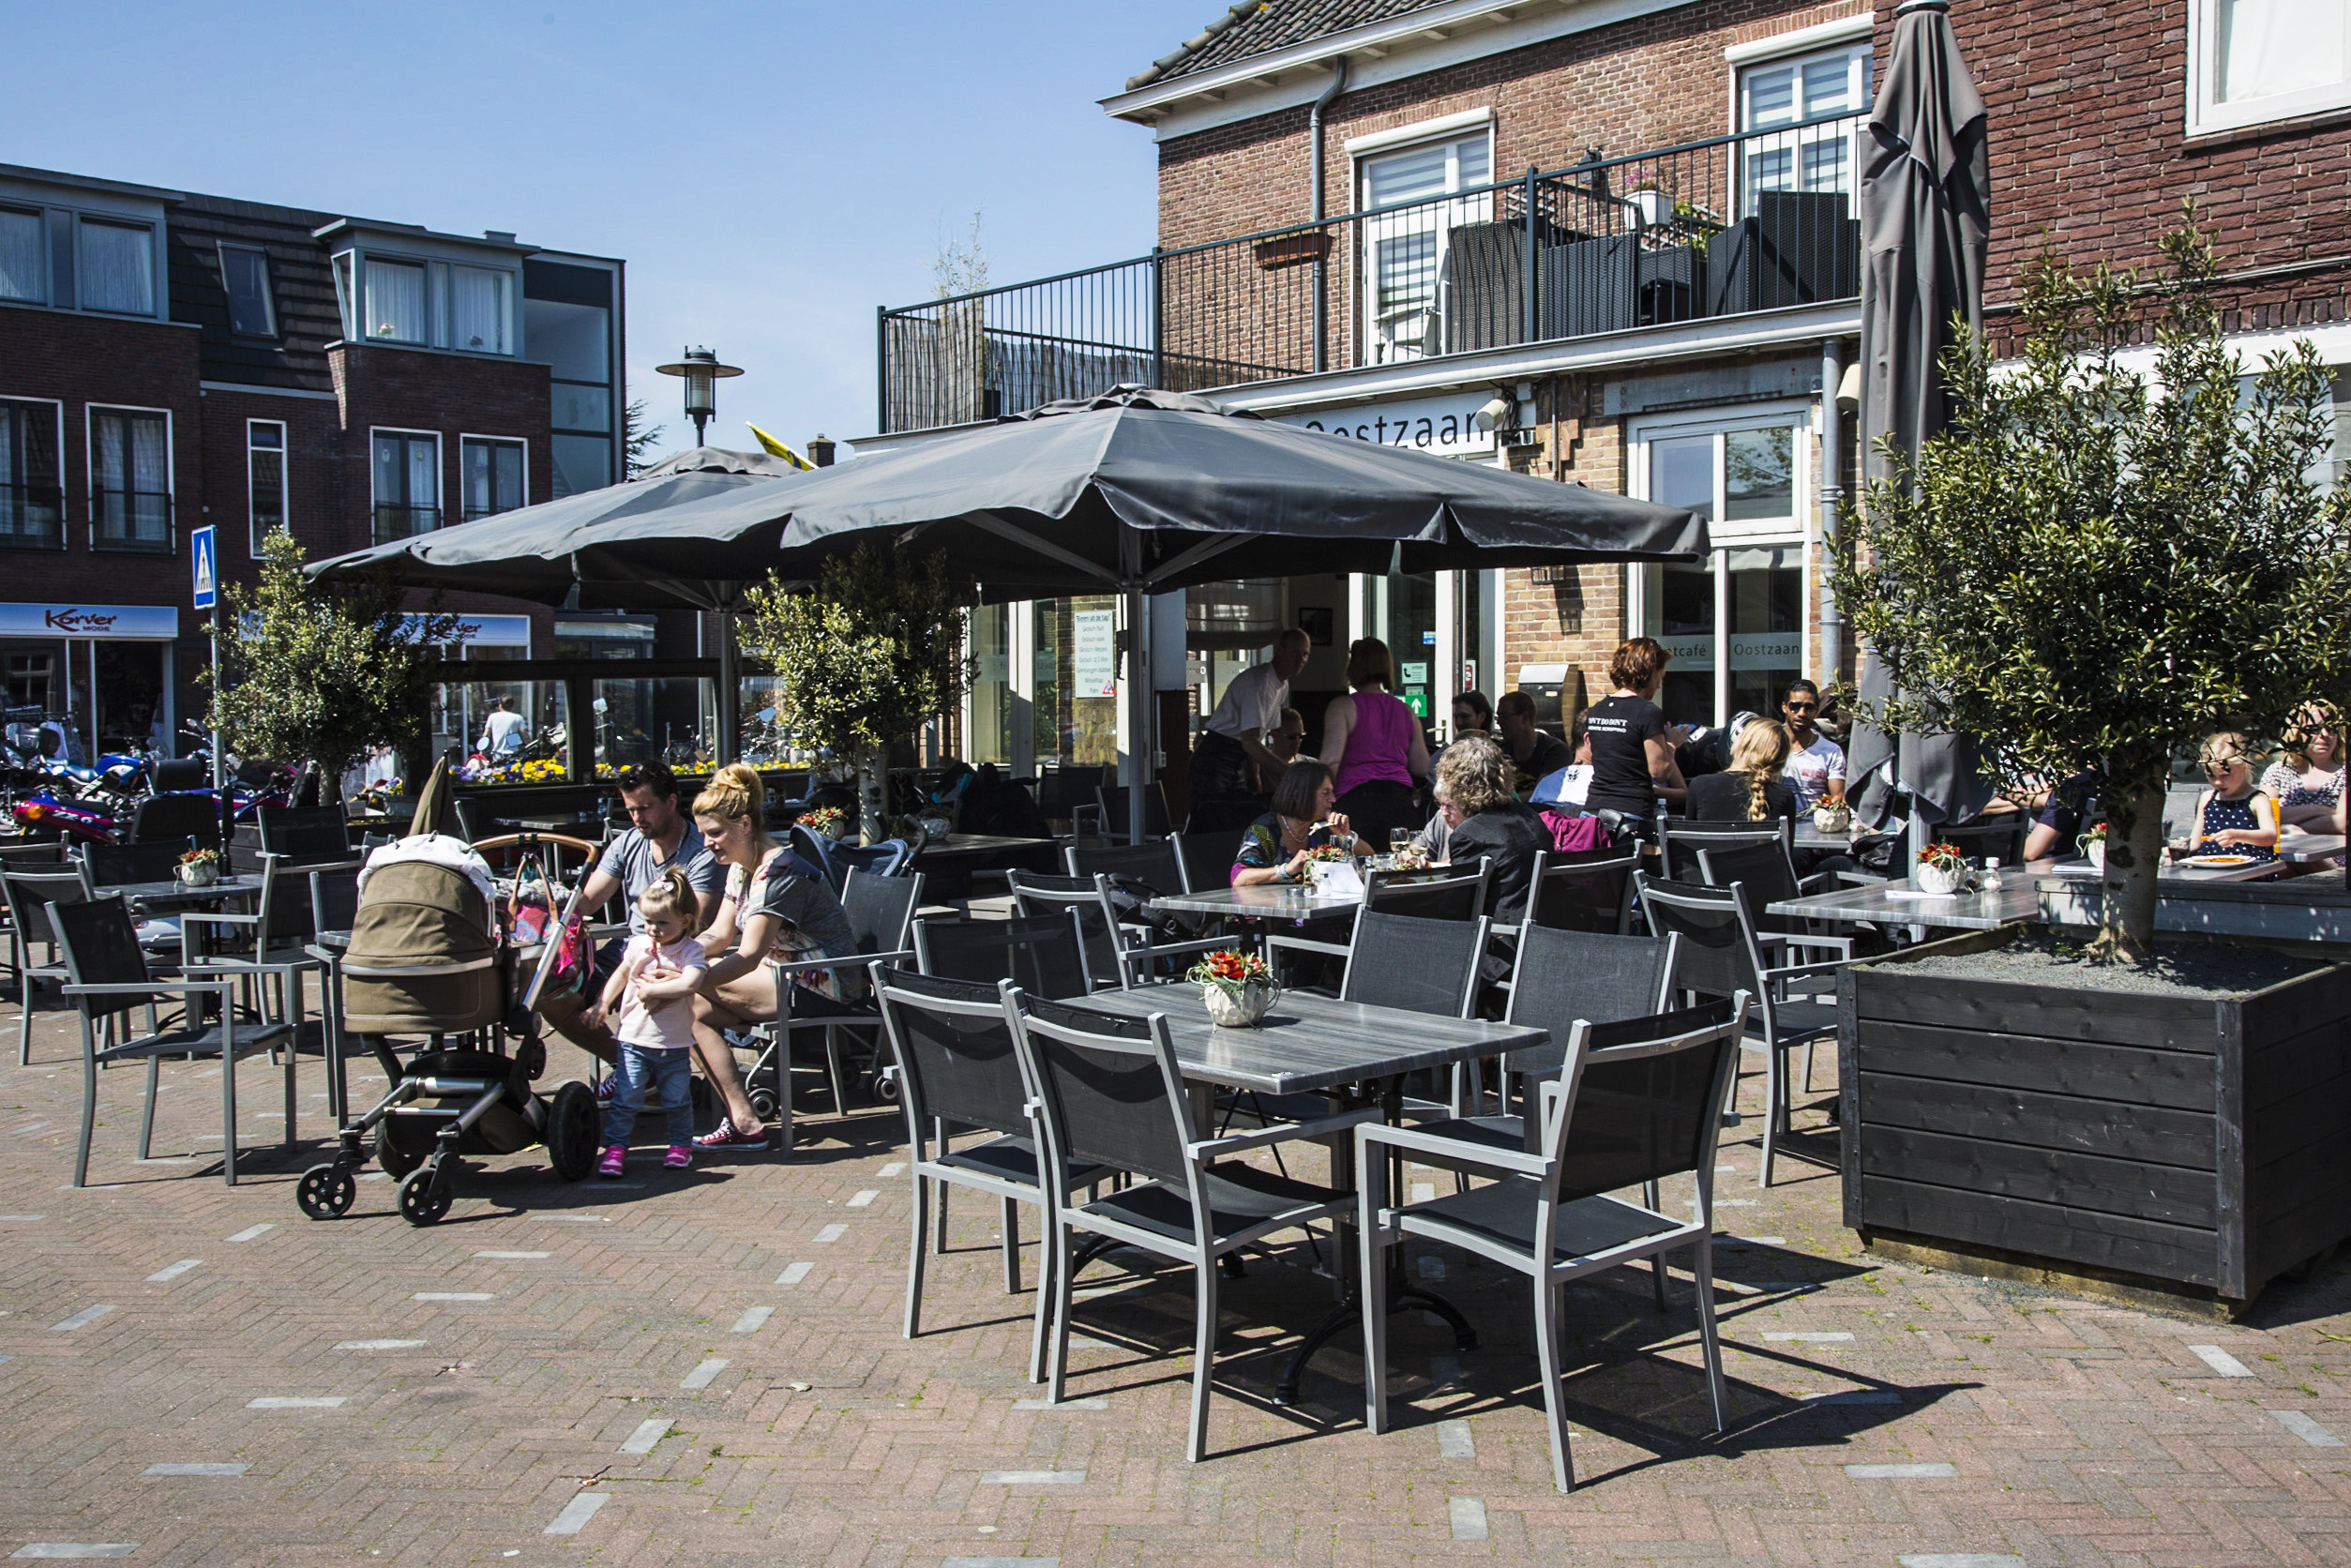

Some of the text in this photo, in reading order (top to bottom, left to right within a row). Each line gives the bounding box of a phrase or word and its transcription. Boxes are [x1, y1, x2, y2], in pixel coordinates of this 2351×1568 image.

[1305, 412, 1484, 449] stzaan
[45, 609, 117, 632] Korver
[1734, 643, 1800, 656] Oostzaan
